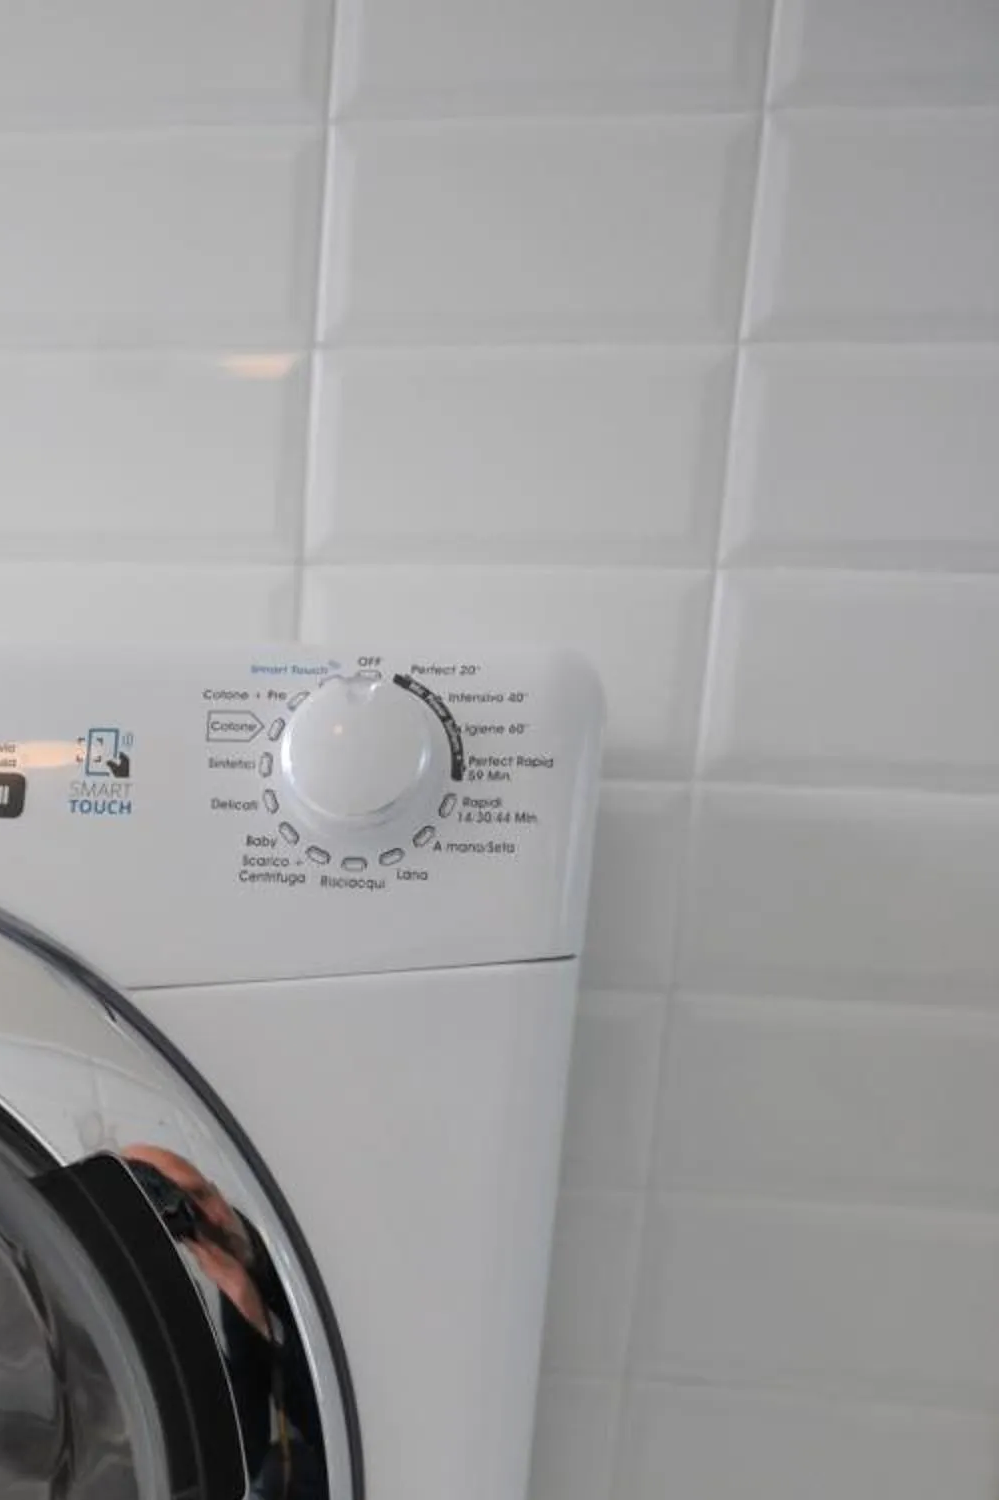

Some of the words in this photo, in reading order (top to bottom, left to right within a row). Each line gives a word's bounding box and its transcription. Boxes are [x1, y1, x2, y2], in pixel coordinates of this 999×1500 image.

[357, 656, 381, 666] OFF
[251, 664, 288, 674] Smart
[292, 664, 328, 675] Touch
[410, 664, 456, 676] Perfect
[210, 720, 257, 732] Cotone
[468, 757, 513, 768] Perfect
[69, 782, 133, 799] SMART
[69, 799, 132, 815] TOUCH
[246, 835, 278, 848] Baby
[242, 855, 290, 868] Scarico
[239, 869, 307, 886] Centrifuga
[396, 869, 429, 881] Lana
